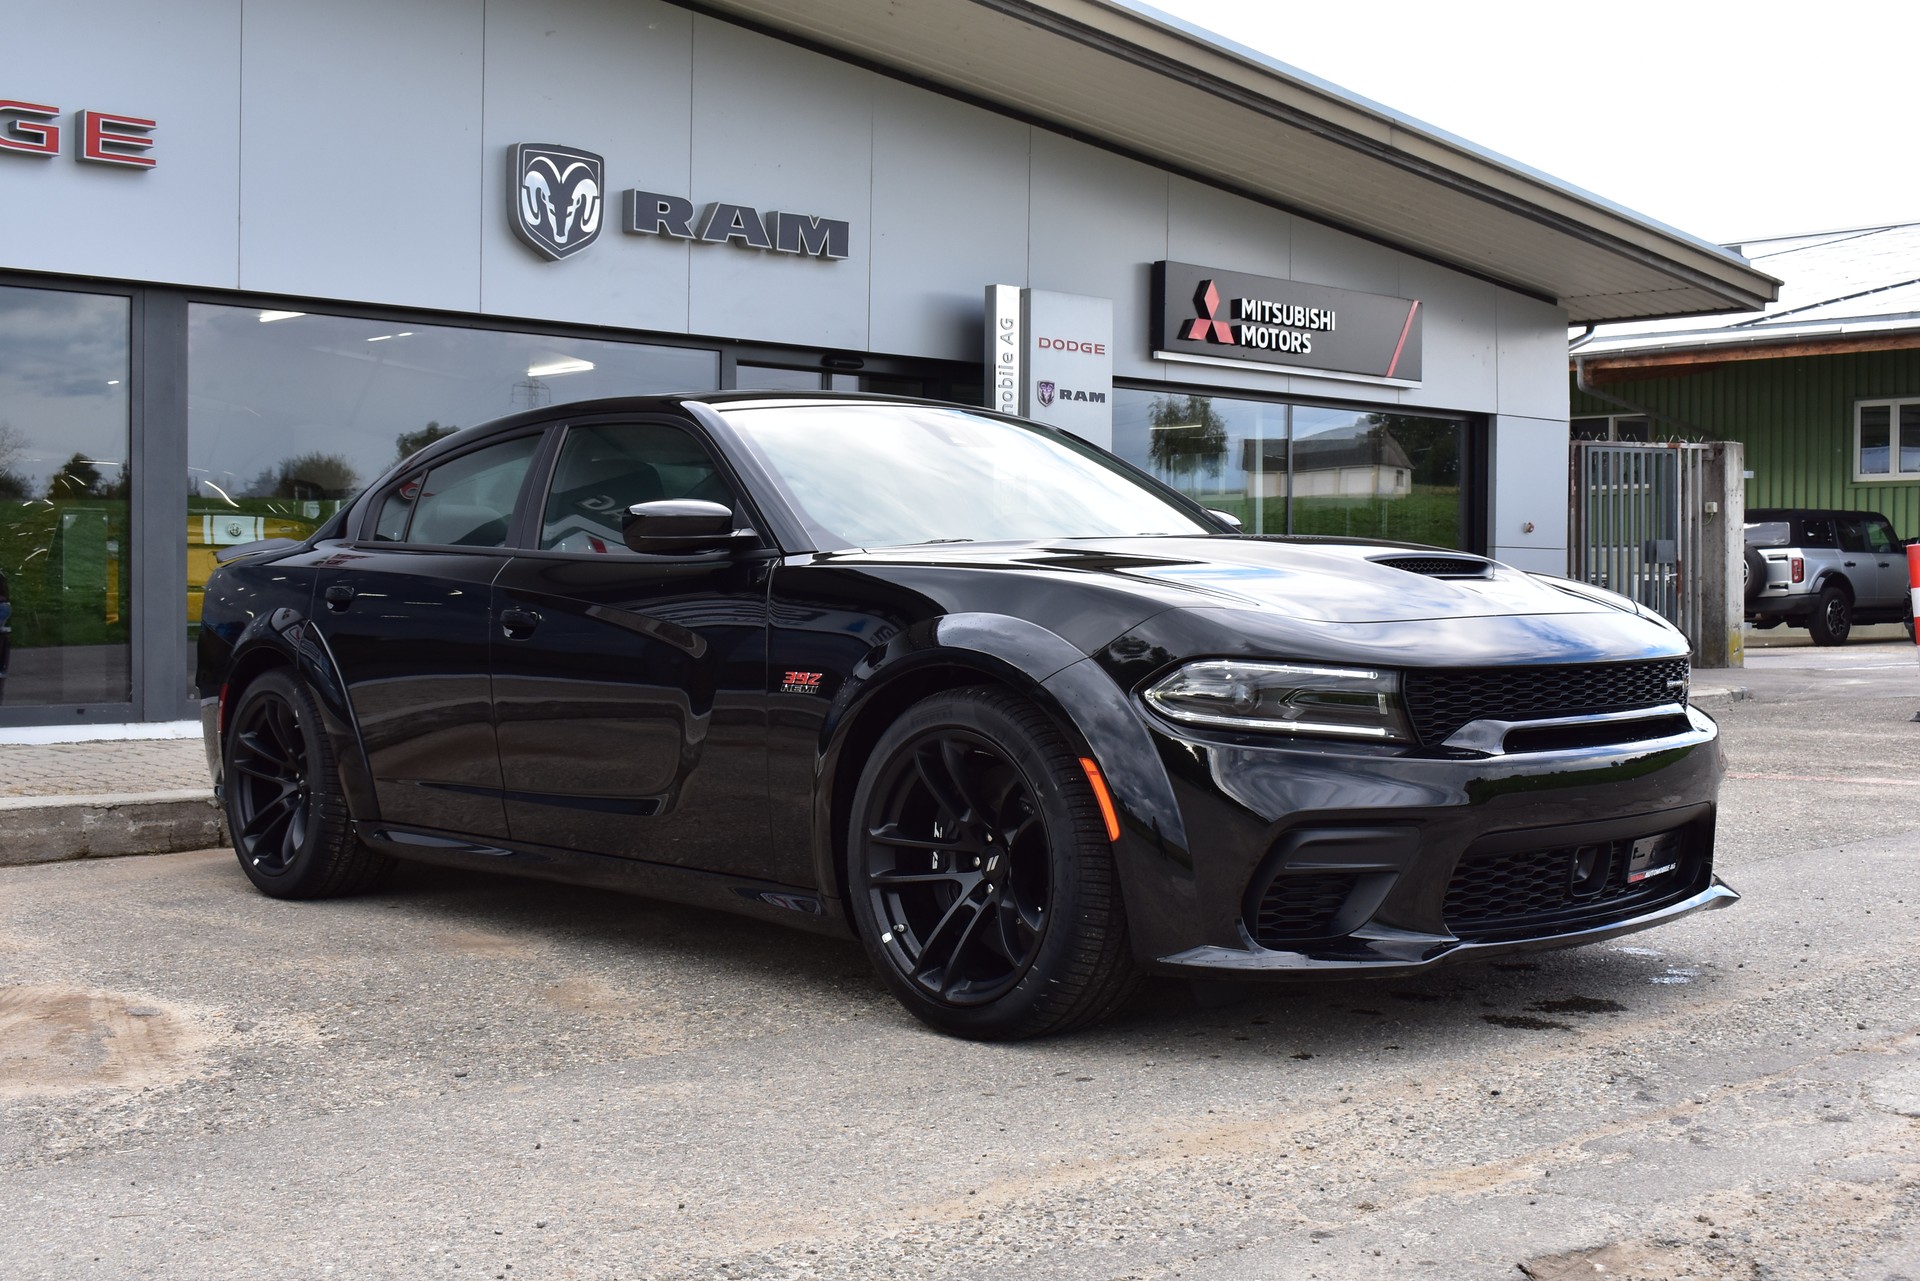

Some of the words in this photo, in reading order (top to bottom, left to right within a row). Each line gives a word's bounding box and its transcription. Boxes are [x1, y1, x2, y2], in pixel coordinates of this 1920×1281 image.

[622, 188, 849, 260] RAM
[1240, 298, 1336, 331] MITSUBISHI
[1000, 318, 1014, 345] AG
[1240, 324, 1312, 354] MOTORS
[1038, 337, 1105, 355] DODGE
[1059, 389, 1106, 403] RAM
[780, 684, 819, 694] HEMI
[783, 672, 822, 685] 392
